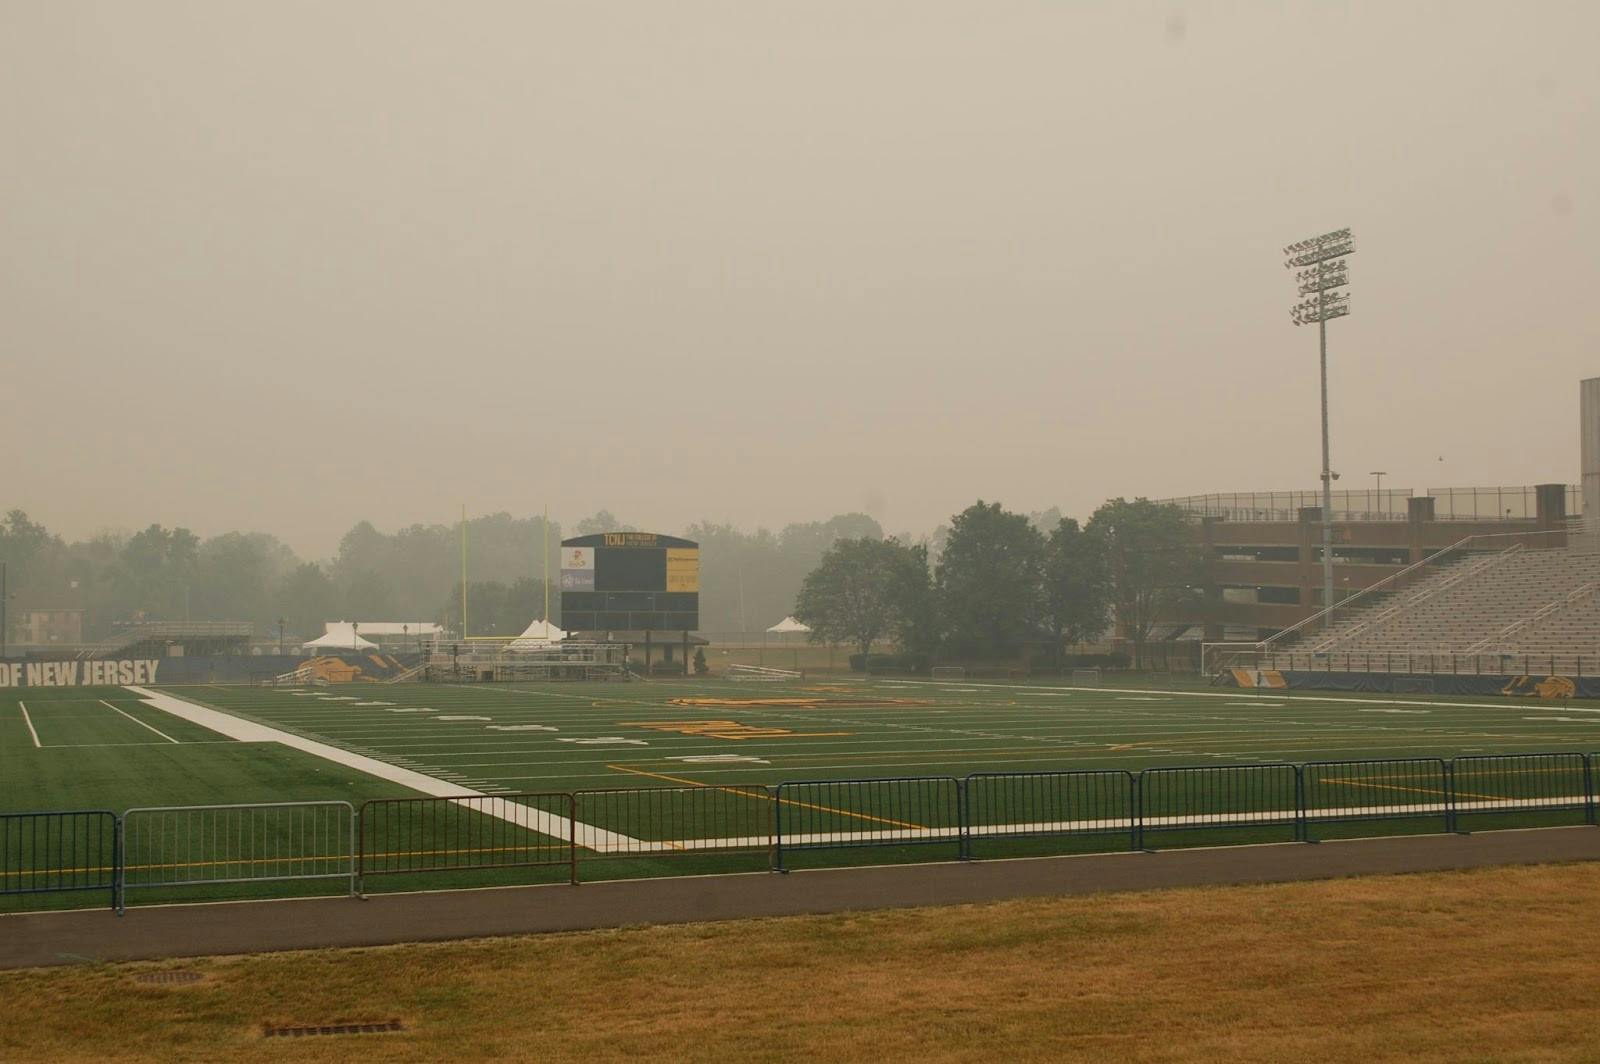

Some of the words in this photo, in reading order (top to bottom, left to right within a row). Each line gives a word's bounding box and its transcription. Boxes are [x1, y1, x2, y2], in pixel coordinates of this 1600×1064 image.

[0, 663, 22, 687] OF
[26, 661, 78, 687] NEW
[82, 659, 160, 686] JERSEY
